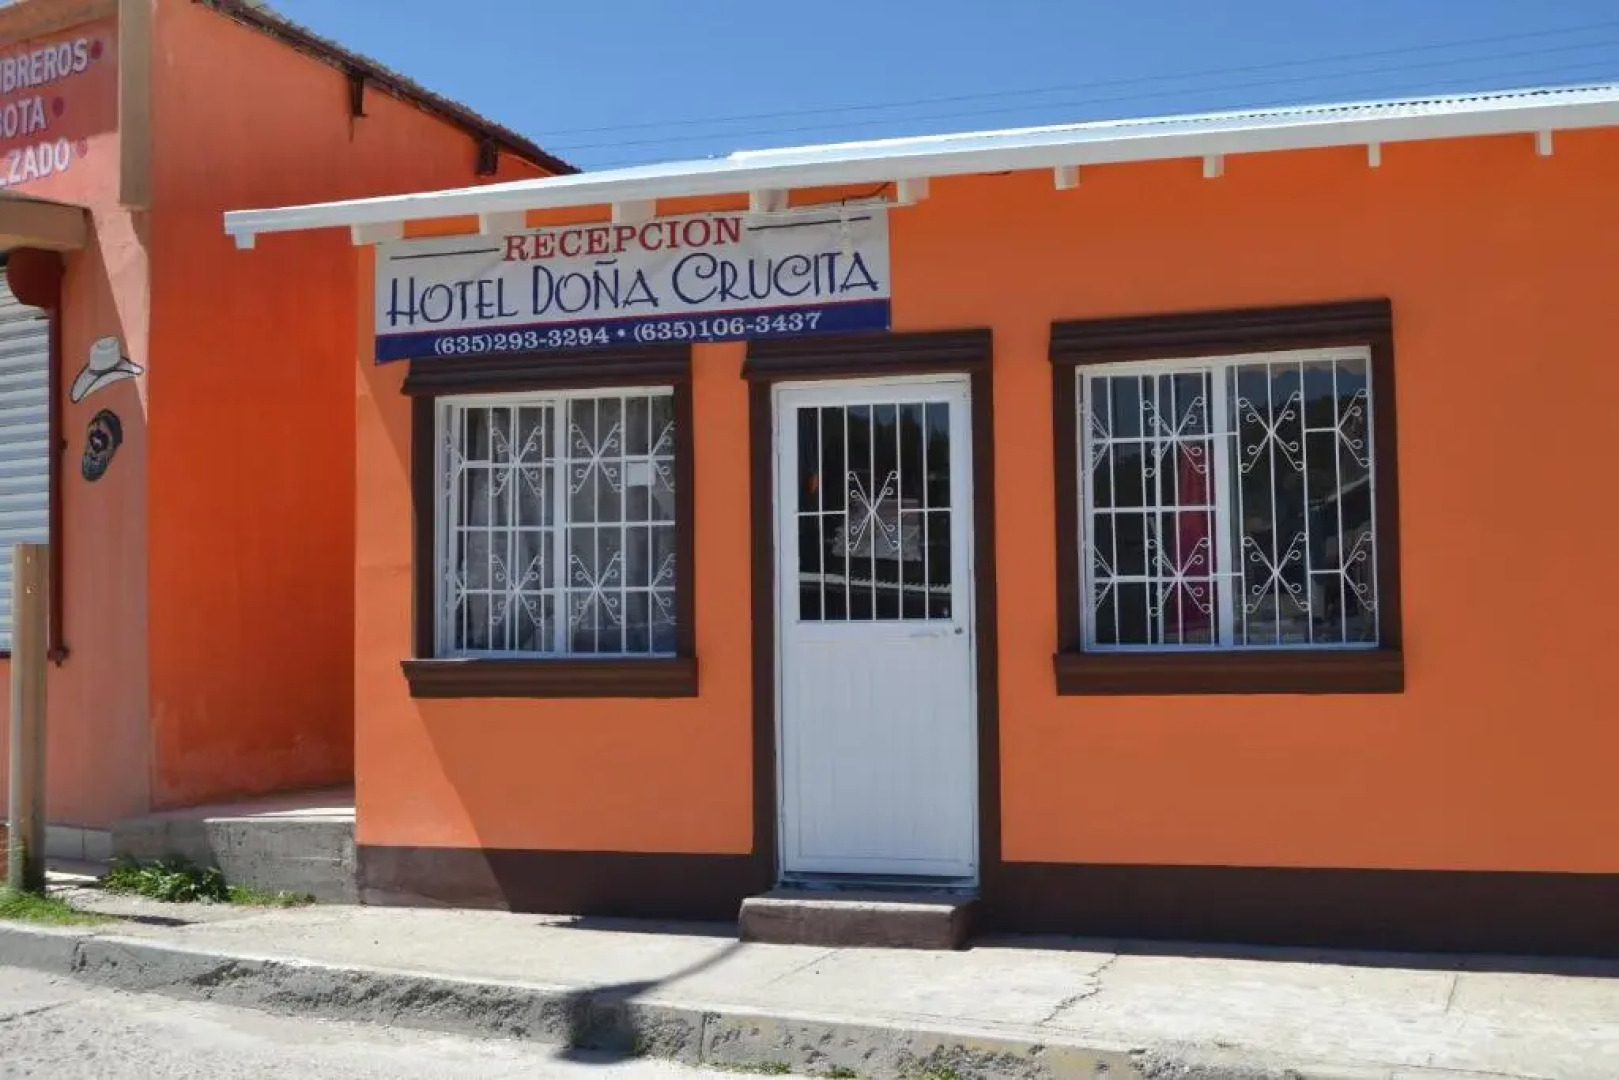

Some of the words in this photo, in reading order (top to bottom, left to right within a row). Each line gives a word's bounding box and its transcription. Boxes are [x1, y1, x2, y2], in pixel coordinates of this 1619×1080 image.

[0, 37, 88, 93] BREROS
[0, 96, 46, 138] OTA
[503, 217, 743, 262] RECEPCION
[386, 276, 519, 326] HOTEL
[532, 259, 659, 315] DOÑA
[671, 252, 879, 304] CRUCITA
[434, 326, 610, 355] (635)293-3294
[633, 310, 822, 343] (635)106-3437
